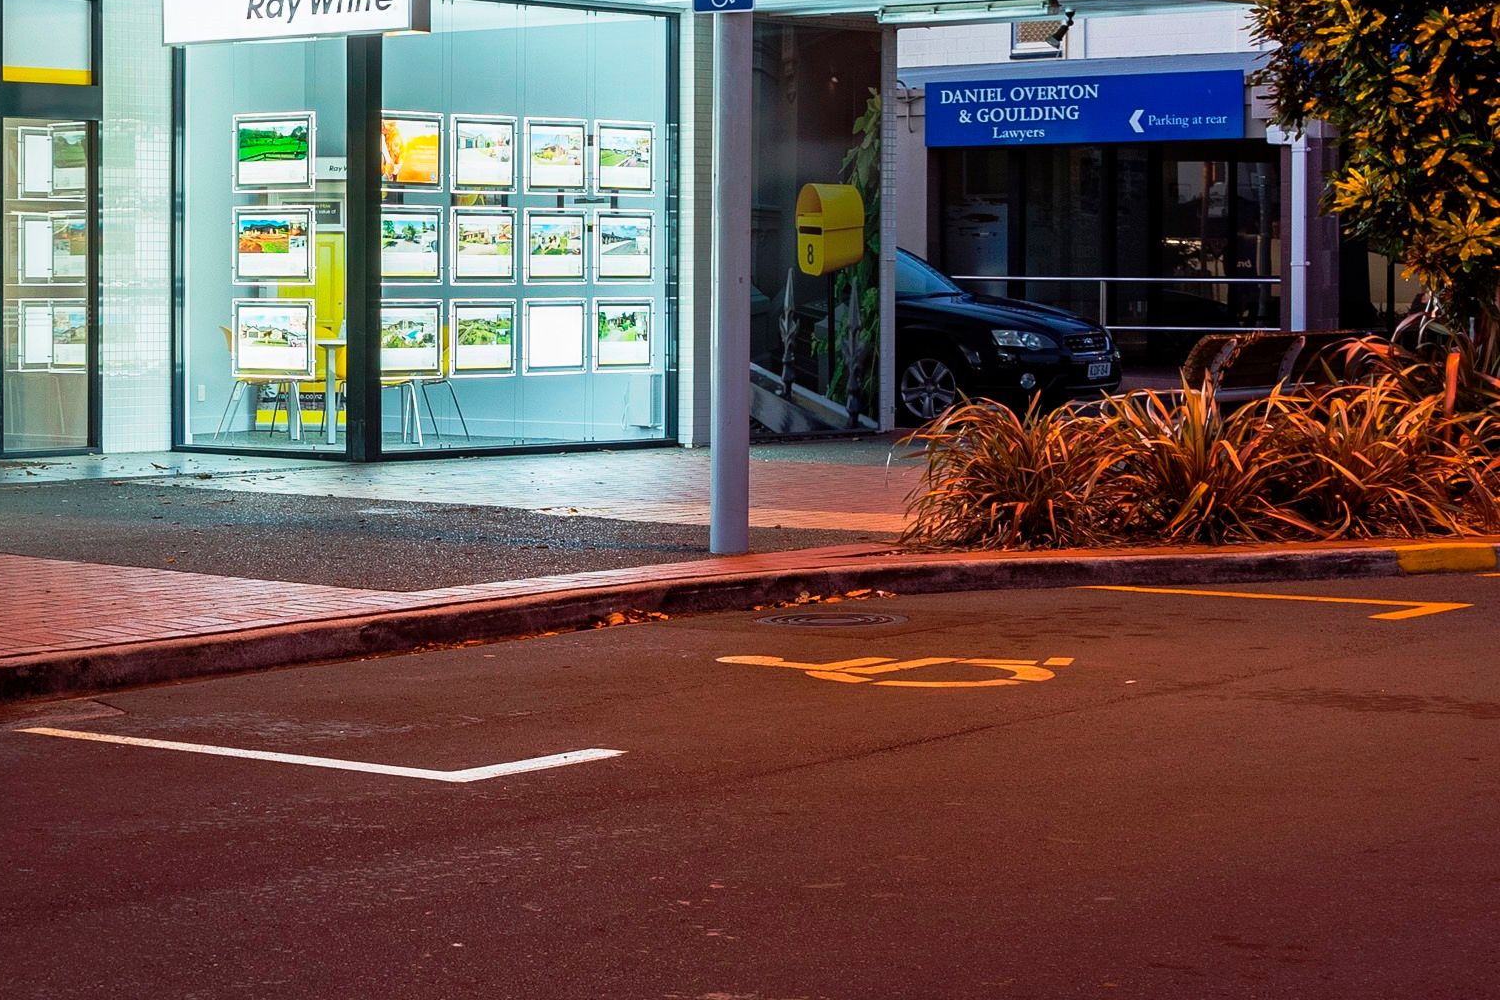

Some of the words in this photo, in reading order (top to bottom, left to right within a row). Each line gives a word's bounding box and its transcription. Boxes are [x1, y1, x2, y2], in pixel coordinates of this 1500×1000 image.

[939, 87, 1006, 104] DANIEL
[1010, 84, 1100, 102] OVERTON
[958, 108, 972, 124] &
[976, 106, 1080, 123] GOULDING
[1148, 114, 1190, 128] Parking
[1192, 115, 1203, 125] at
[1206, 115, 1228, 125] rear
[992, 126, 1045, 142] Lawyers
[807, 243, 814, 265] 8
